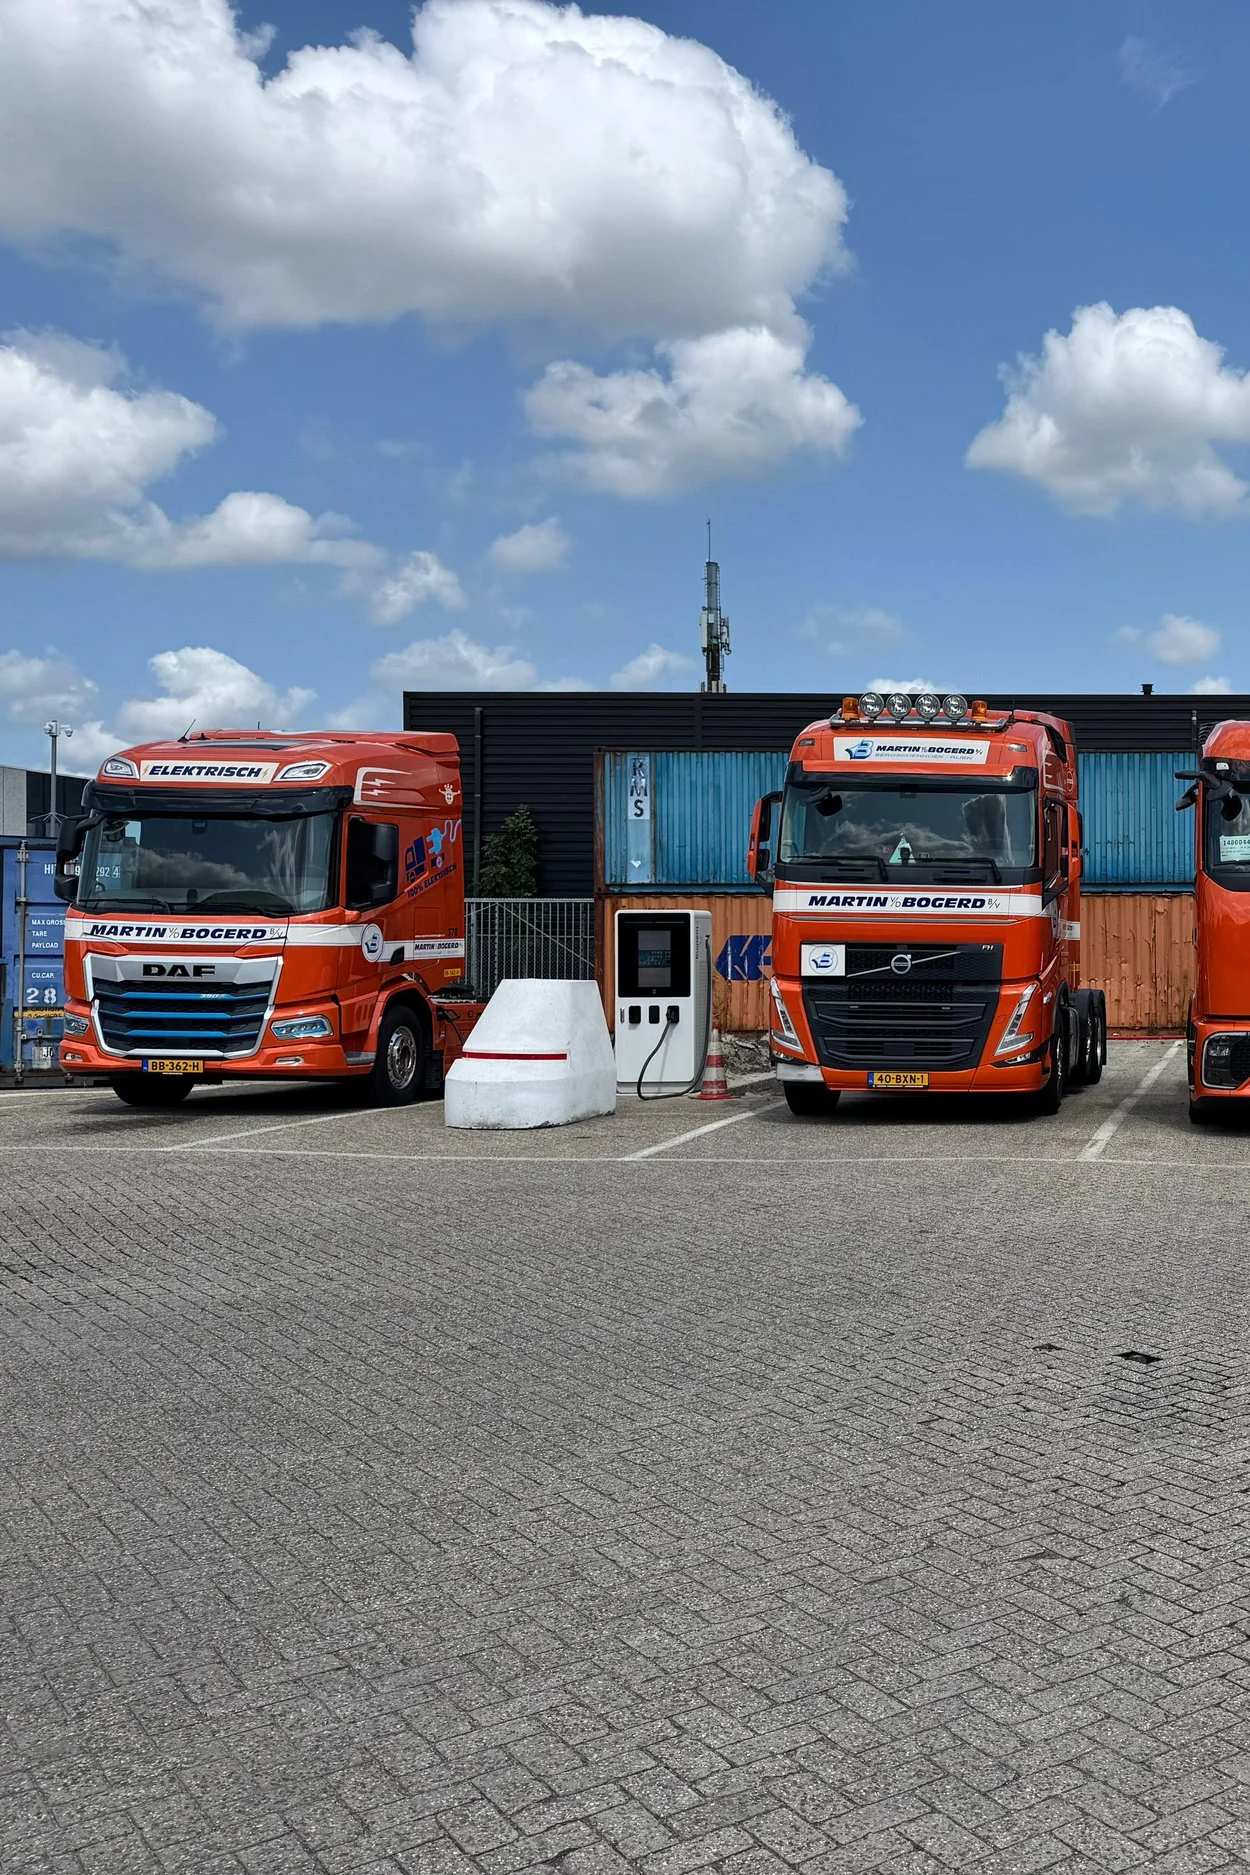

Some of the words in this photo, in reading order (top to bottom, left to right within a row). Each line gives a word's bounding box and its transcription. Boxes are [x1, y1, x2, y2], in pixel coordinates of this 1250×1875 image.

[149, 765, 262, 777] ELEKTRISCH
[808, 896, 888, 907] MARTIN
[902, 898, 986, 908] BOGERD
[90, 924, 167, 938] MARTIN
[180, 928, 267, 939] BOGERD
[142, 964, 215, 977] DAF
[151, 1062, 199, 1071] BB-362-H
[878, 1074, 924, 1083] 40-BXN-1
